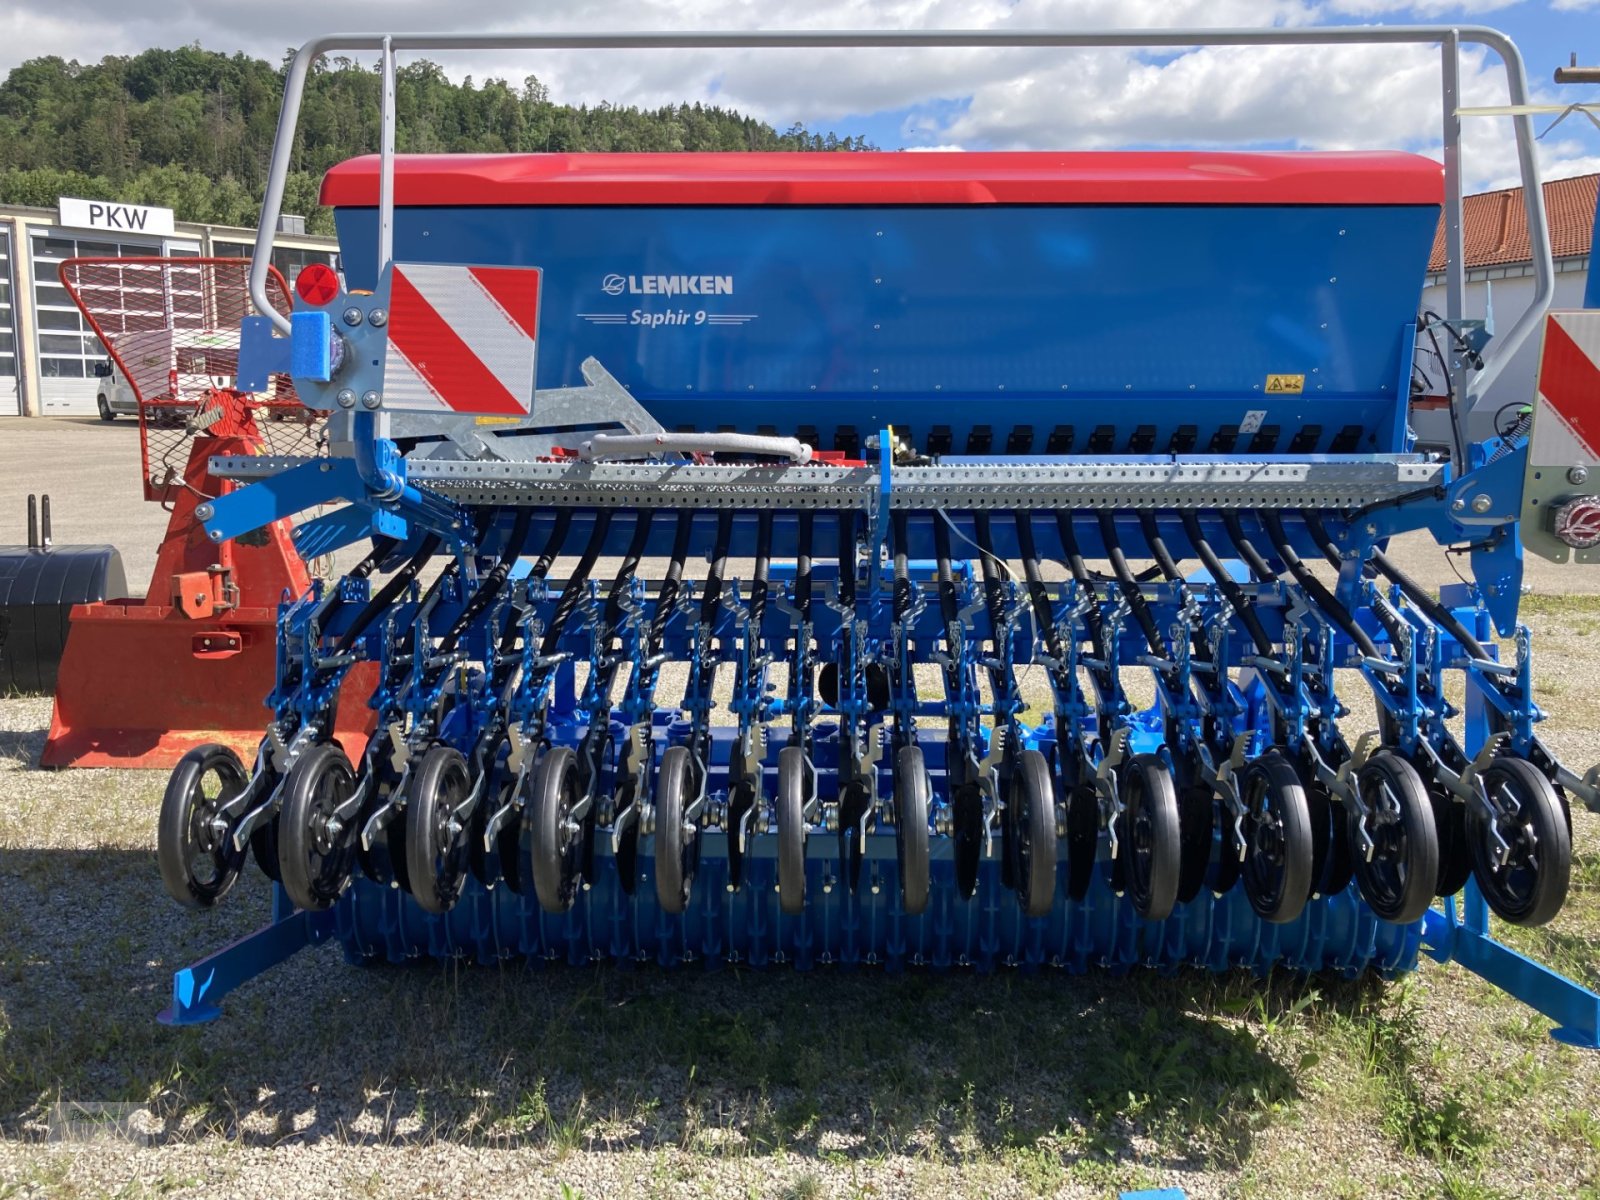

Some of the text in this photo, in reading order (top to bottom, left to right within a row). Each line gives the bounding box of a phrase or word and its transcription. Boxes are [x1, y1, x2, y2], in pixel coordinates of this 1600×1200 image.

[89, 203, 148, 230] PKW
[629, 275, 733, 299] LEMKEN
[630, 309, 706, 328] Saphir 9
